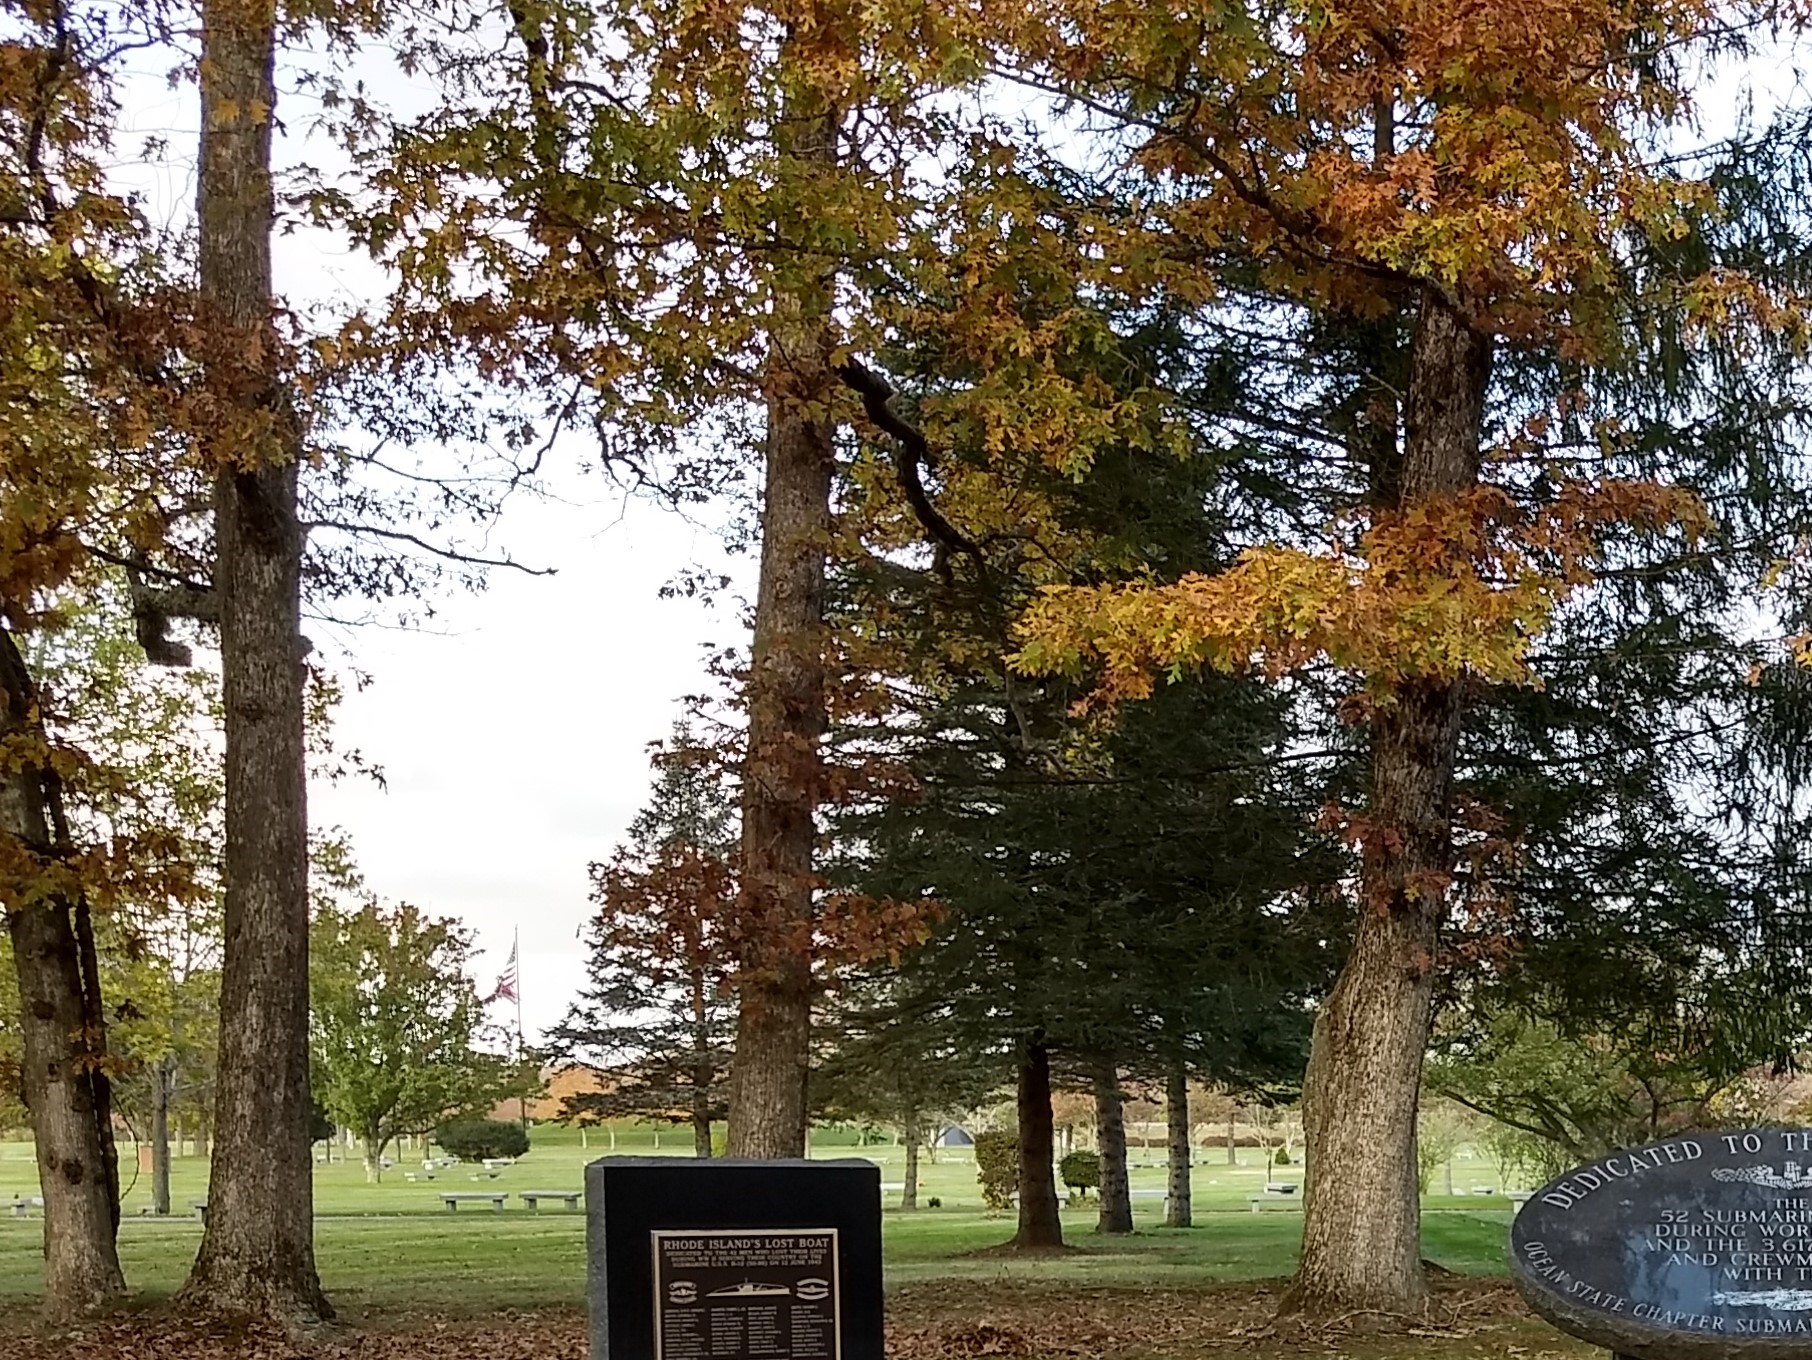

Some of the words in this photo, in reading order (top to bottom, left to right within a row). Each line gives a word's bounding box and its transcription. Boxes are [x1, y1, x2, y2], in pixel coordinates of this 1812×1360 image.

[1541, 1140, 1703, 1211] DEDICATED
[1721, 1133, 1762, 1154] TO
[1772, 1198, 1810, 1210] THE
[1659, 1210, 1689, 1223] 52
[1655, 1223, 1747, 1238] DURING
[663, 1240, 705, 1251] RHODE
[708, 1239, 761, 1250] ISLAND'S
[765, 1238, 795, 1249] LOST
[799, 1238, 830, 1248] BOAT
[1645, 1238, 1691, 1252] AND
[1706, 1238, 1750, 1252] THE
[1666, 1252, 1719, 1267] AND
[1723, 1267, 1783, 1282] WITH
[1523, 1240, 1570, 1285] OCEAN
[1566, 1279, 1628, 1313] STATE
[1631, 1302, 1725, 1332] CHAPTER
